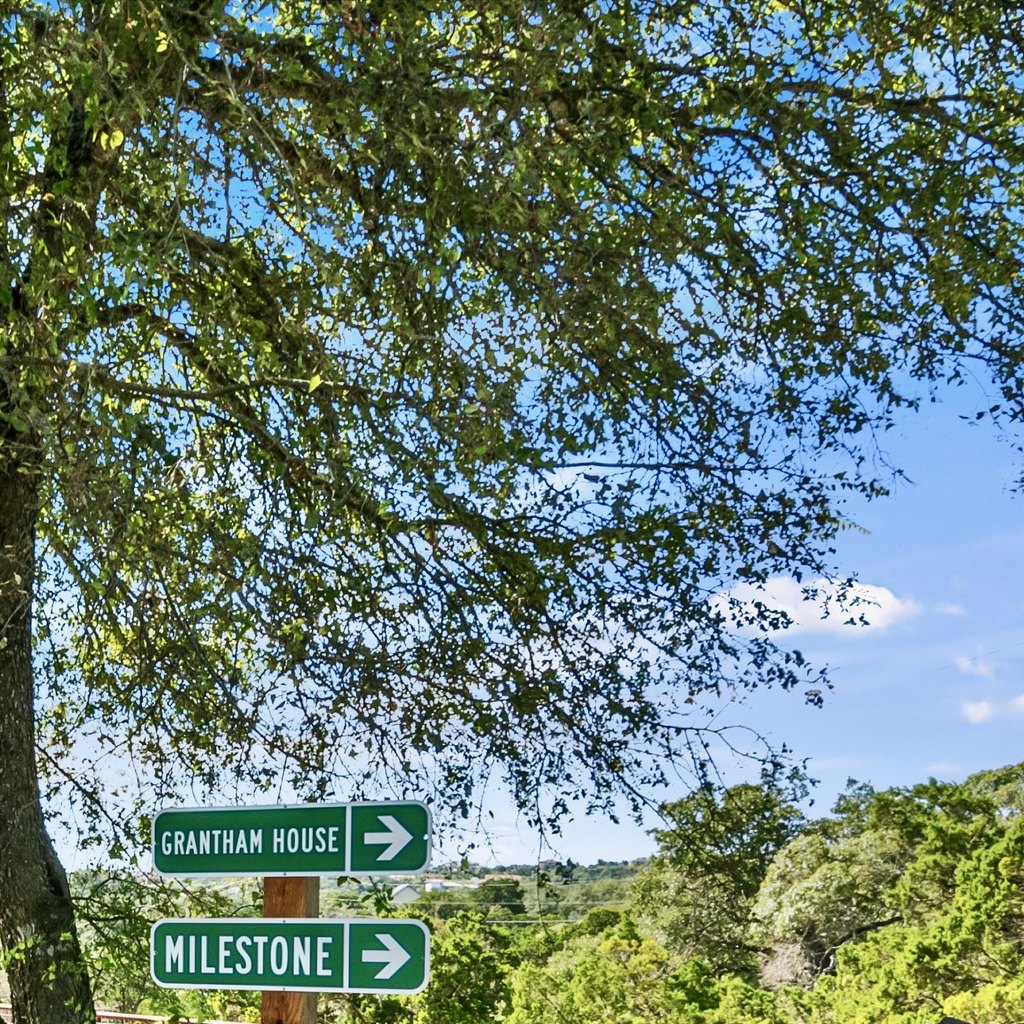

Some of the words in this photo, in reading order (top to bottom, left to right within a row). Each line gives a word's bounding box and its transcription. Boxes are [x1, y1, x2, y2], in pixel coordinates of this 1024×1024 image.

[161, 829, 263, 855] GRANTHAM
[273, 827, 339, 853] HOUSE
[165, 935, 333, 976] MILESTONE
